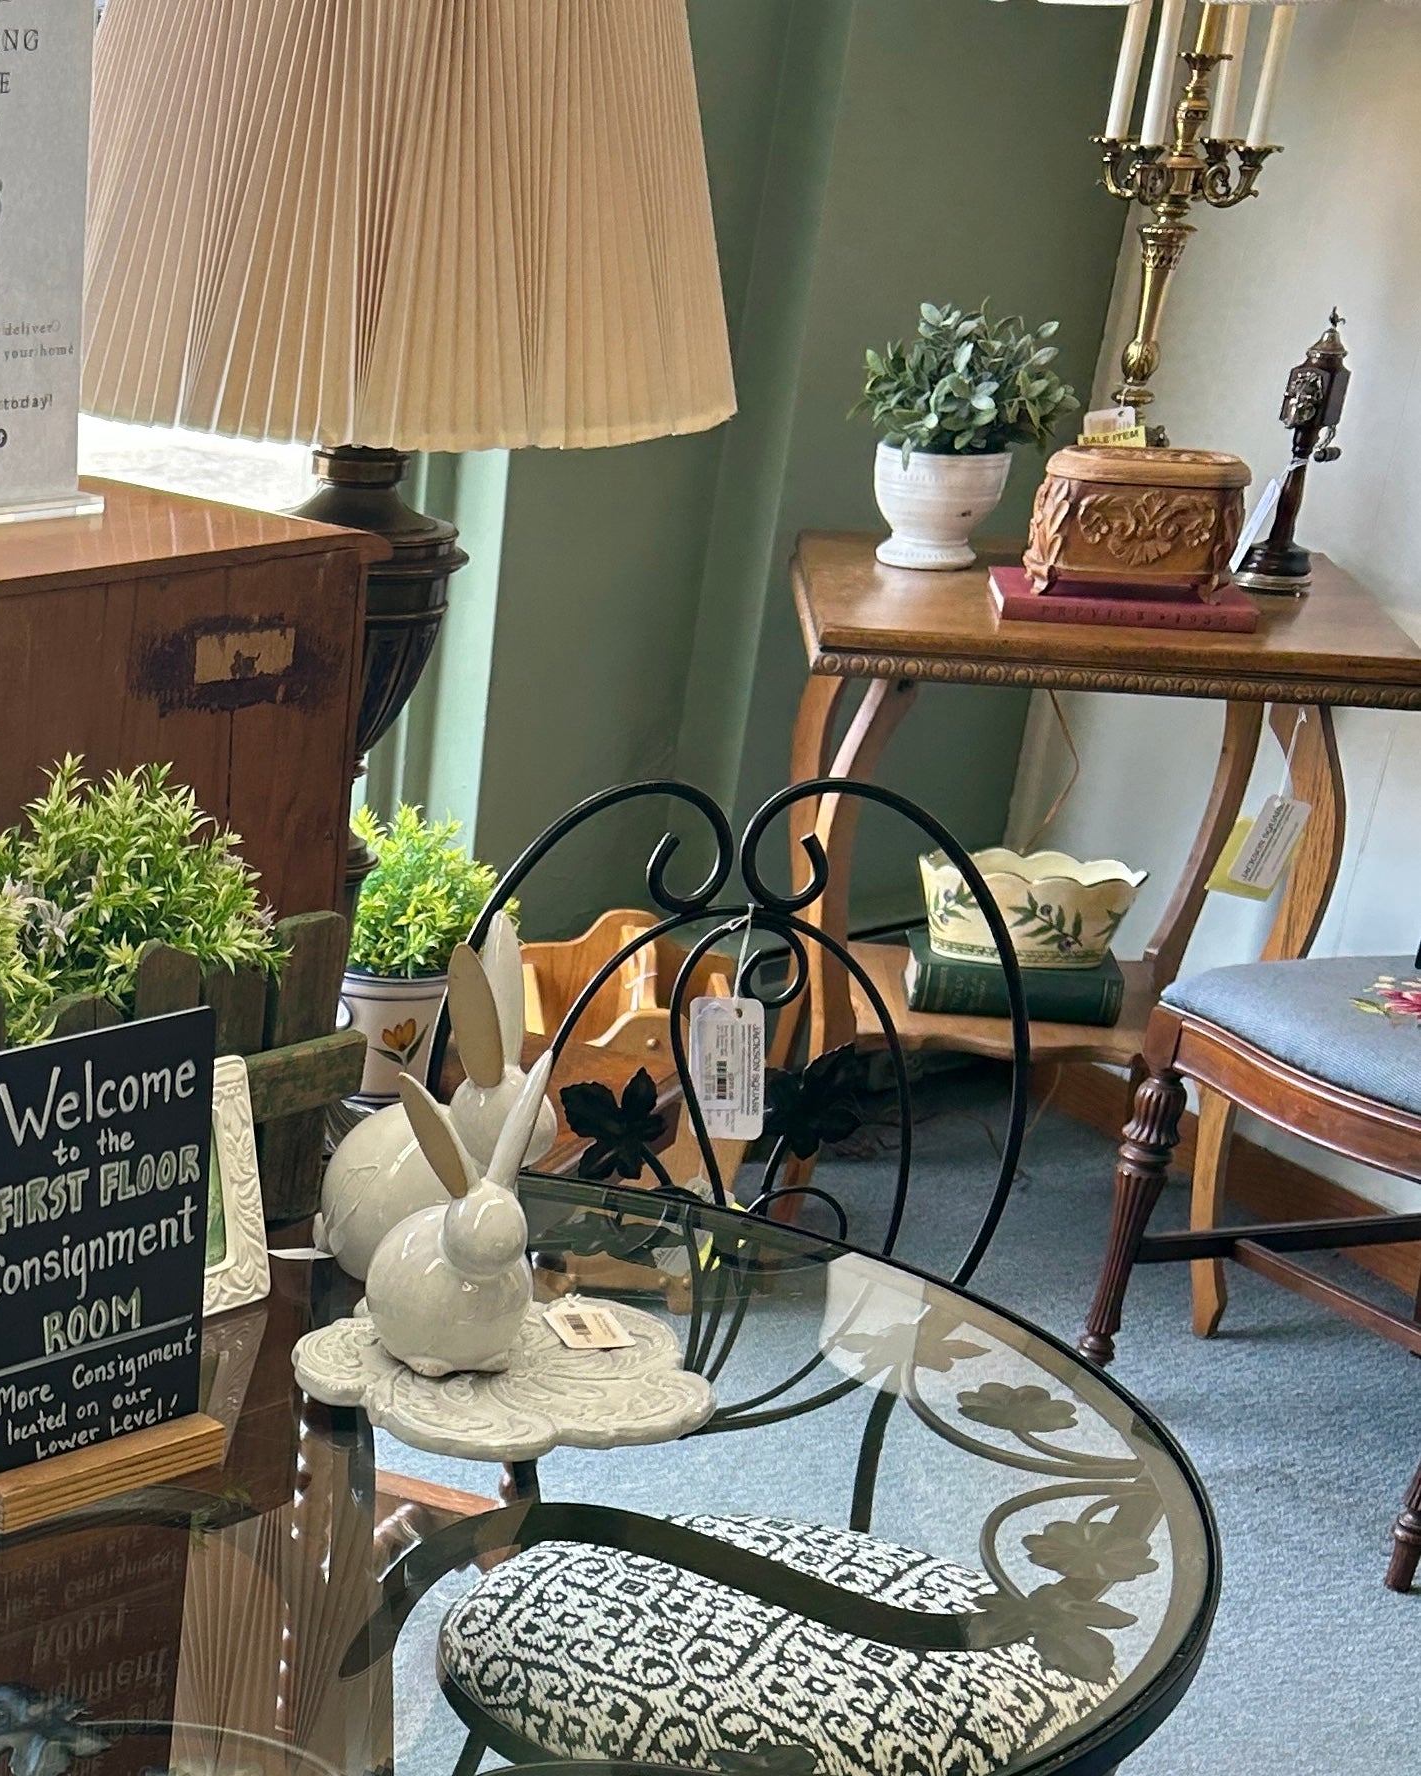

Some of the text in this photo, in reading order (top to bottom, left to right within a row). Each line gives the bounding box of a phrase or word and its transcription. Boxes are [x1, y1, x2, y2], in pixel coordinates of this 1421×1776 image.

[4, 322, 54, 336] deliver
[4, 349, 34, 361] your
[3, 394, 53, 410] today!
[1083, 430, 1139, 445] SALE ITEM
[751, 1024, 761, 1116] JACKSON SQUARE
[52, 1128, 135, 1167] to the
[99, 1144, 201, 1208] FLOOR
[42, 1286, 141, 1356] ROOM
[72, 1327, 197, 1389] Consignment
[7, 1386, 152, 1446] located on our
[35, 1394, 178, 1460] Lower Level!
